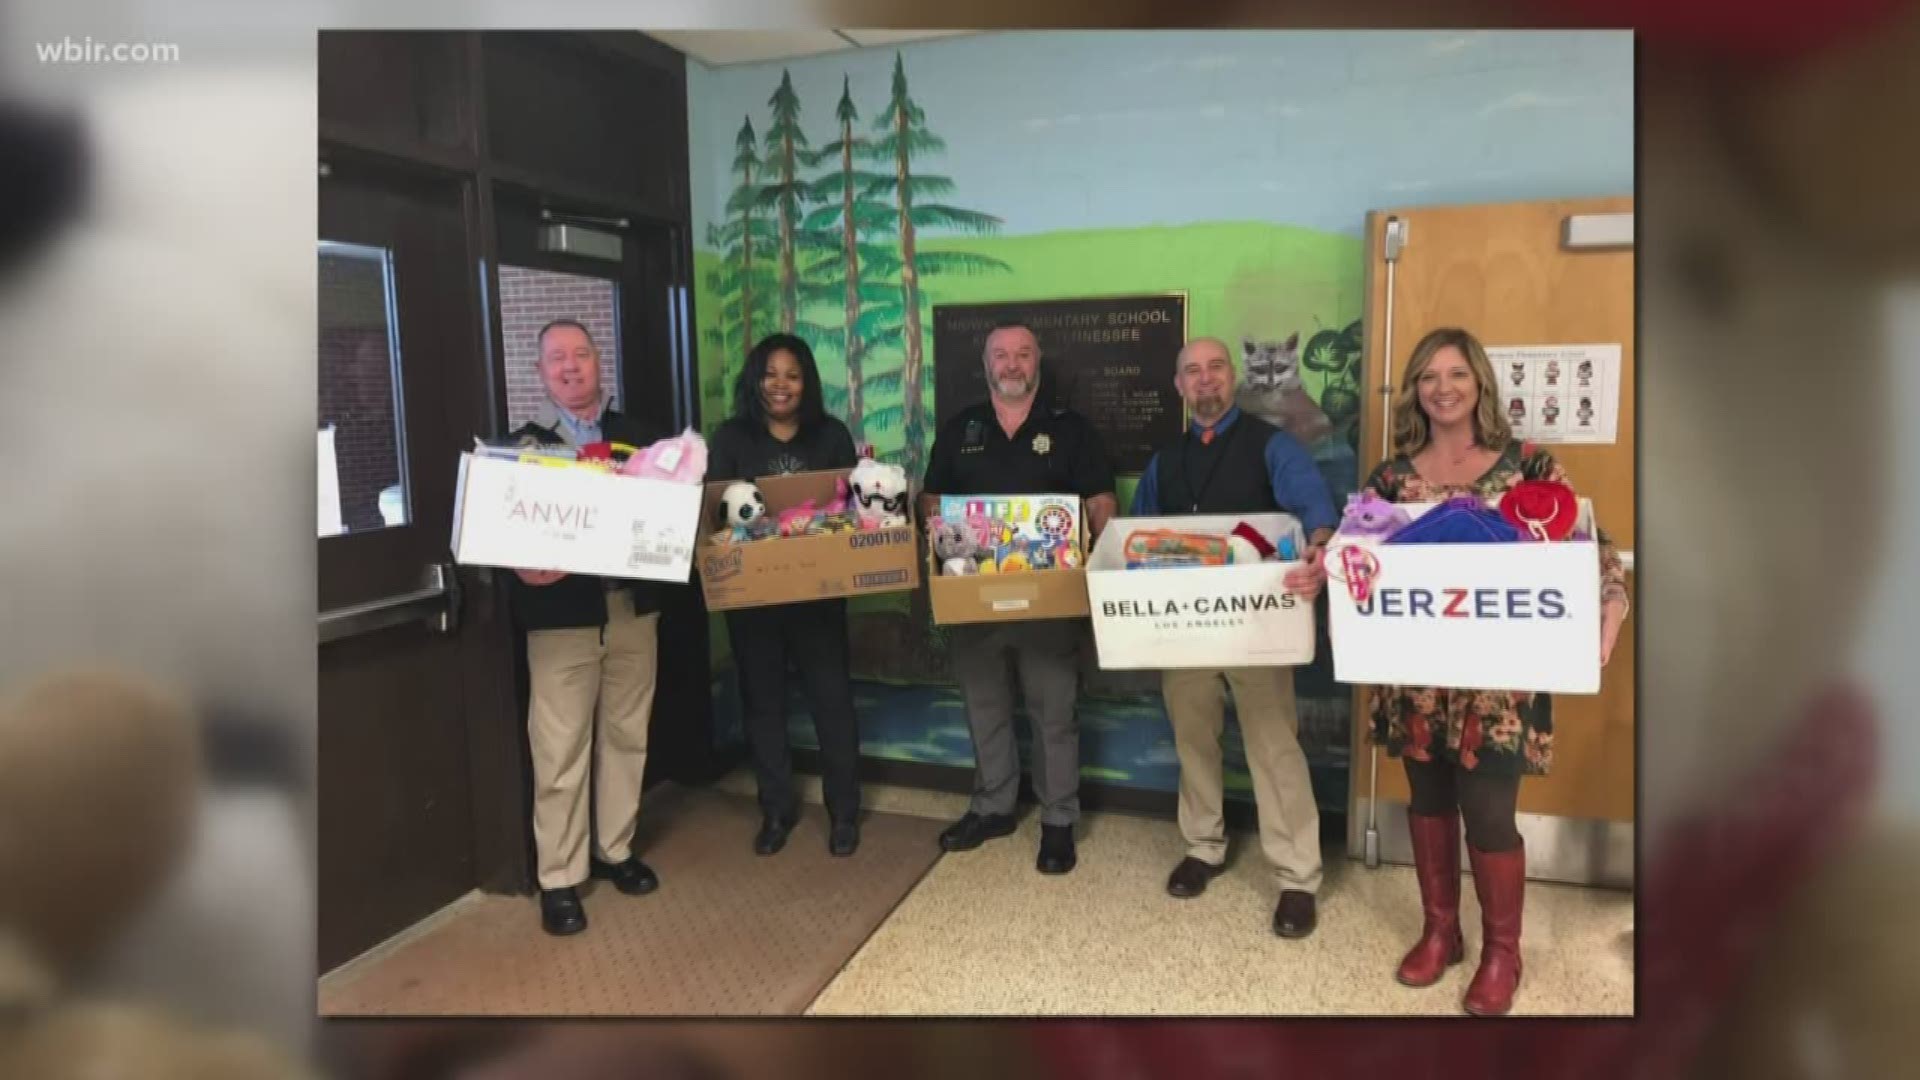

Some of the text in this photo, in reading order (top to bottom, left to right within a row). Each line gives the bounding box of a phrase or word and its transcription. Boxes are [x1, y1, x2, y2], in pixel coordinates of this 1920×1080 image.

[1108, 310, 1172, 325] SCHOOL
[968, 502, 1027, 519] LIFE
[1154, 618, 1245, 630] LOS ANGELES
